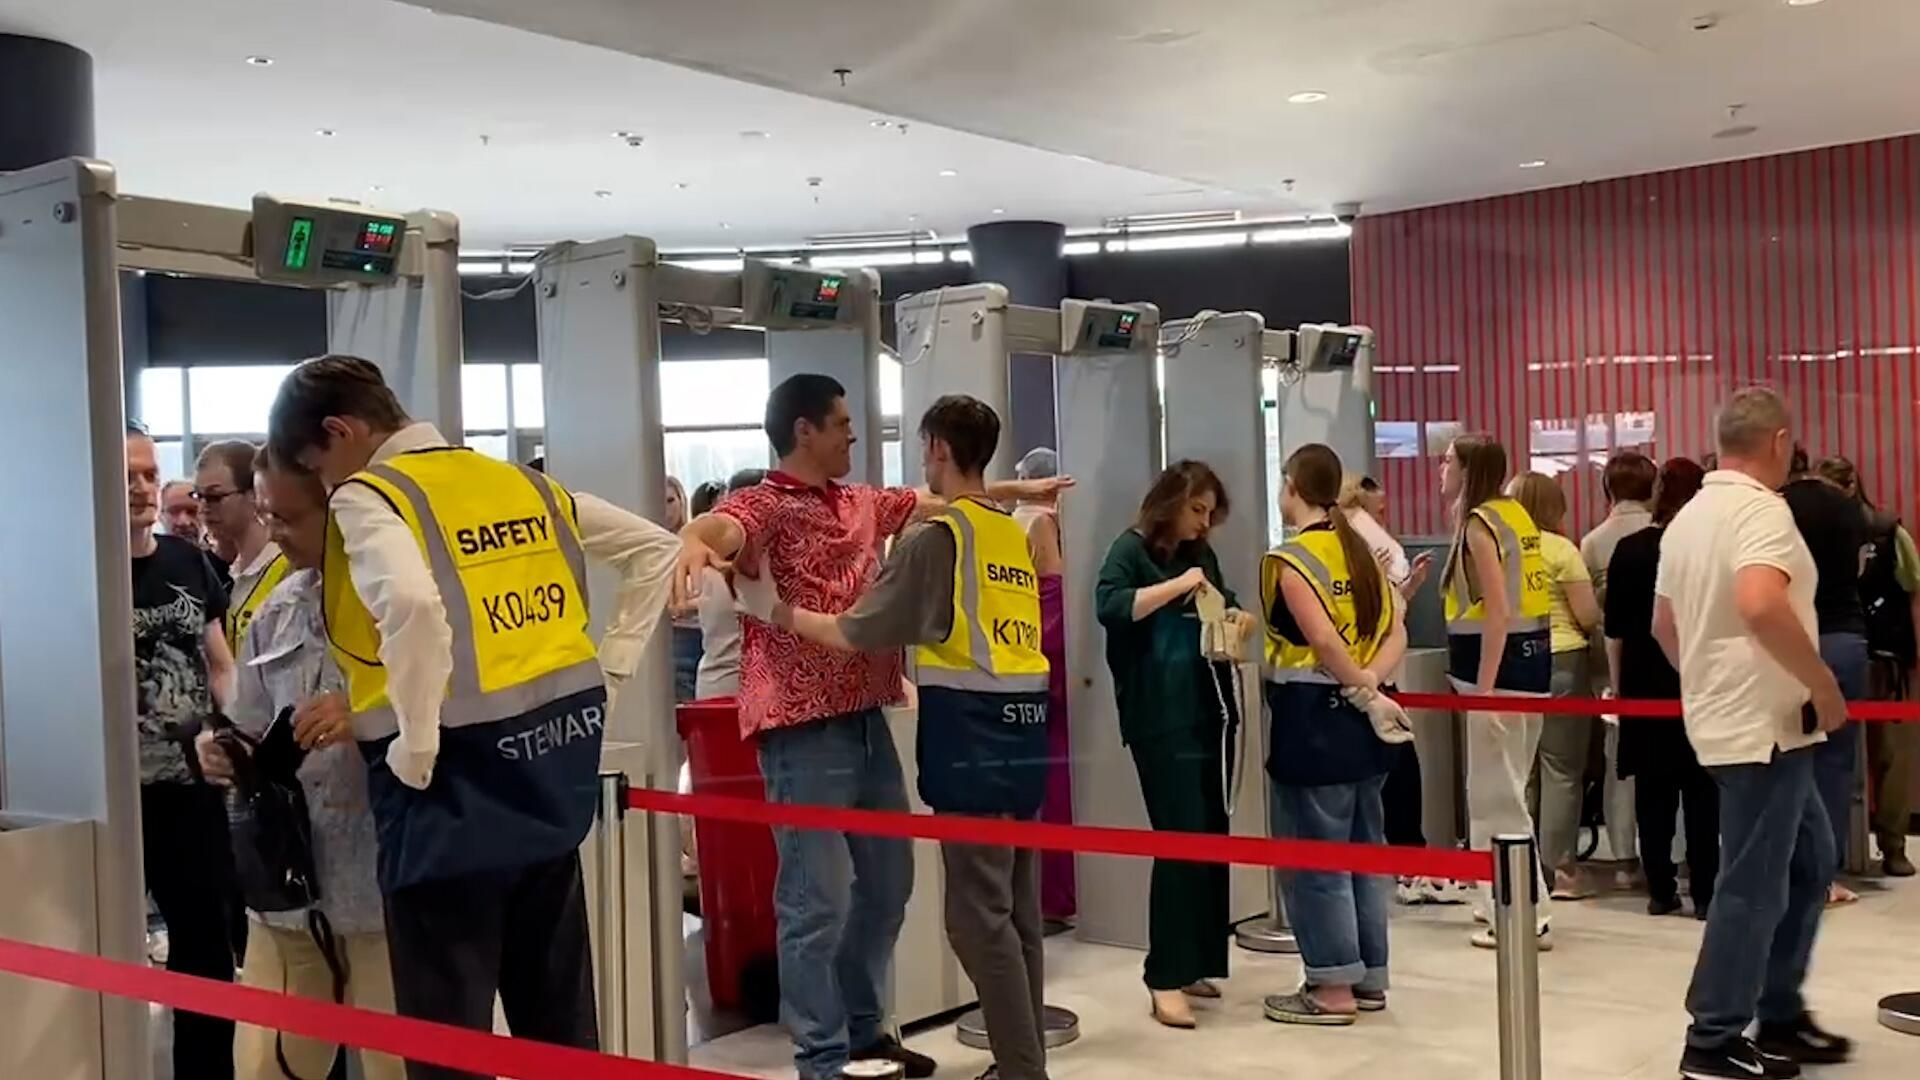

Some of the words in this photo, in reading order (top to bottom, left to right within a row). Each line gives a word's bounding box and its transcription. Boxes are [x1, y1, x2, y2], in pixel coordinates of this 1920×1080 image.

[456, 516, 548, 555] SAFETY
[482, 583, 566, 634] K0439
[496, 702, 606, 761] STEWAR
